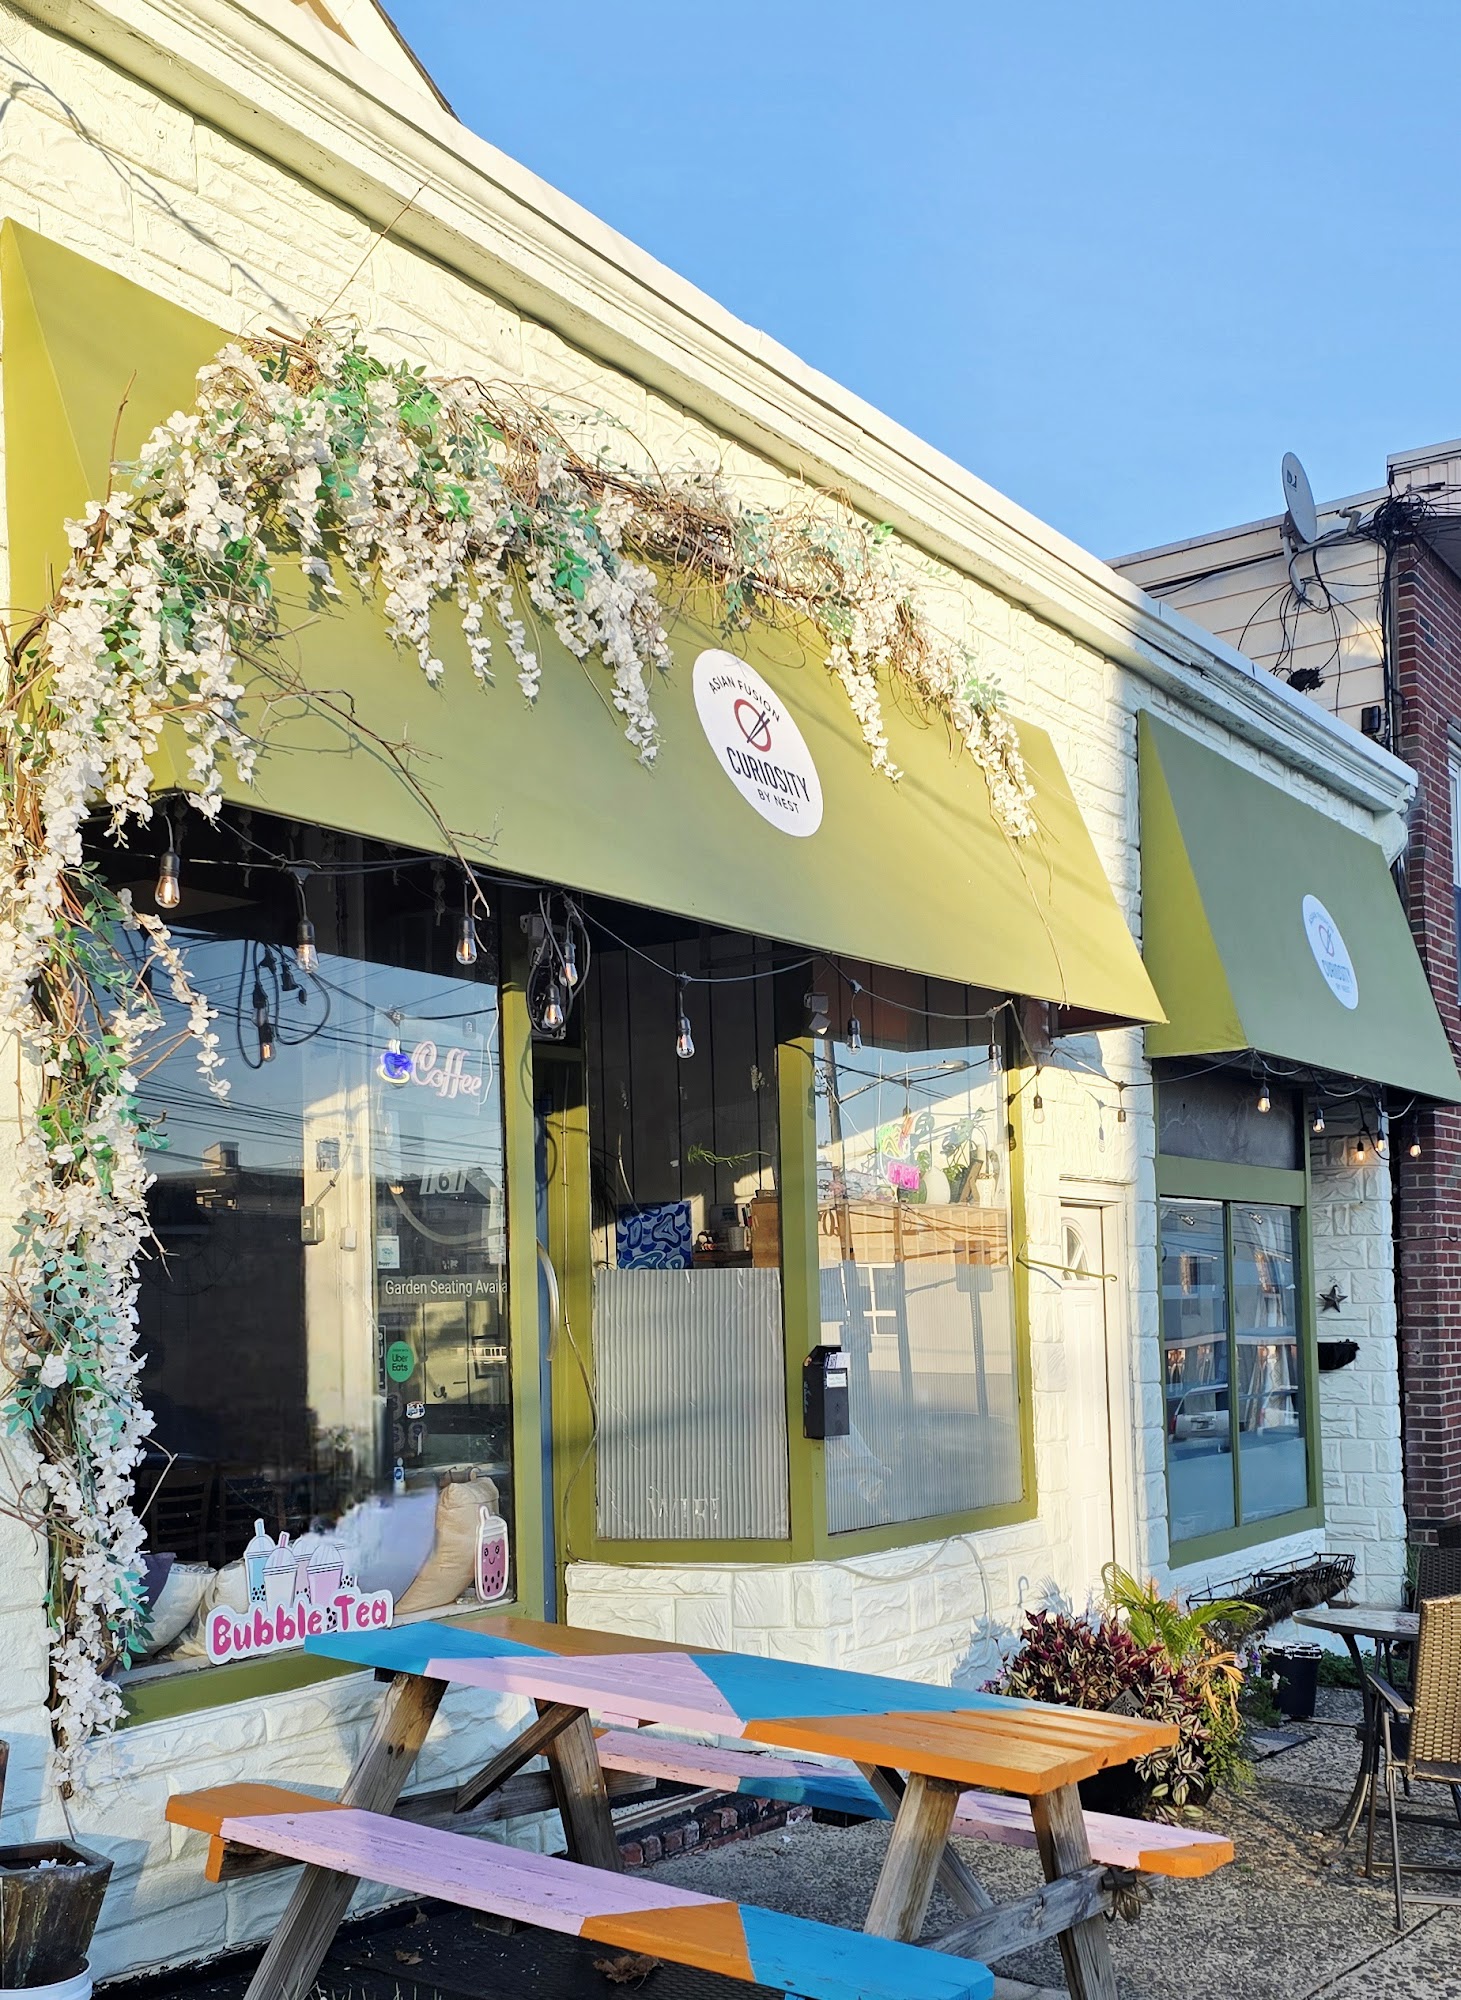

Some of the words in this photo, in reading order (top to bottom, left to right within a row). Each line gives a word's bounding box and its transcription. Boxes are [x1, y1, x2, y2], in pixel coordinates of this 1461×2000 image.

[708, 674, 736, 694] ASIAN
[737, 679, 780, 723] FUSION
[726, 746, 810, 802] CURIOSITY
[757, 788, 771, 803] BY
[773, 795, 799, 814] NEST
[411, 1040, 482, 1098] Coffee
[385, 1279, 427, 1295] Garden
[430, 1279, 473, 1298] Seating
[475, 1278, 508, 1293] Avaia
[391, 1353, 409, 1363] Uber
[391, 1363, 409, 1372] Eats
[213, 1599, 323, 1656] Bubble
[334, 1595, 387, 1631] Tea
